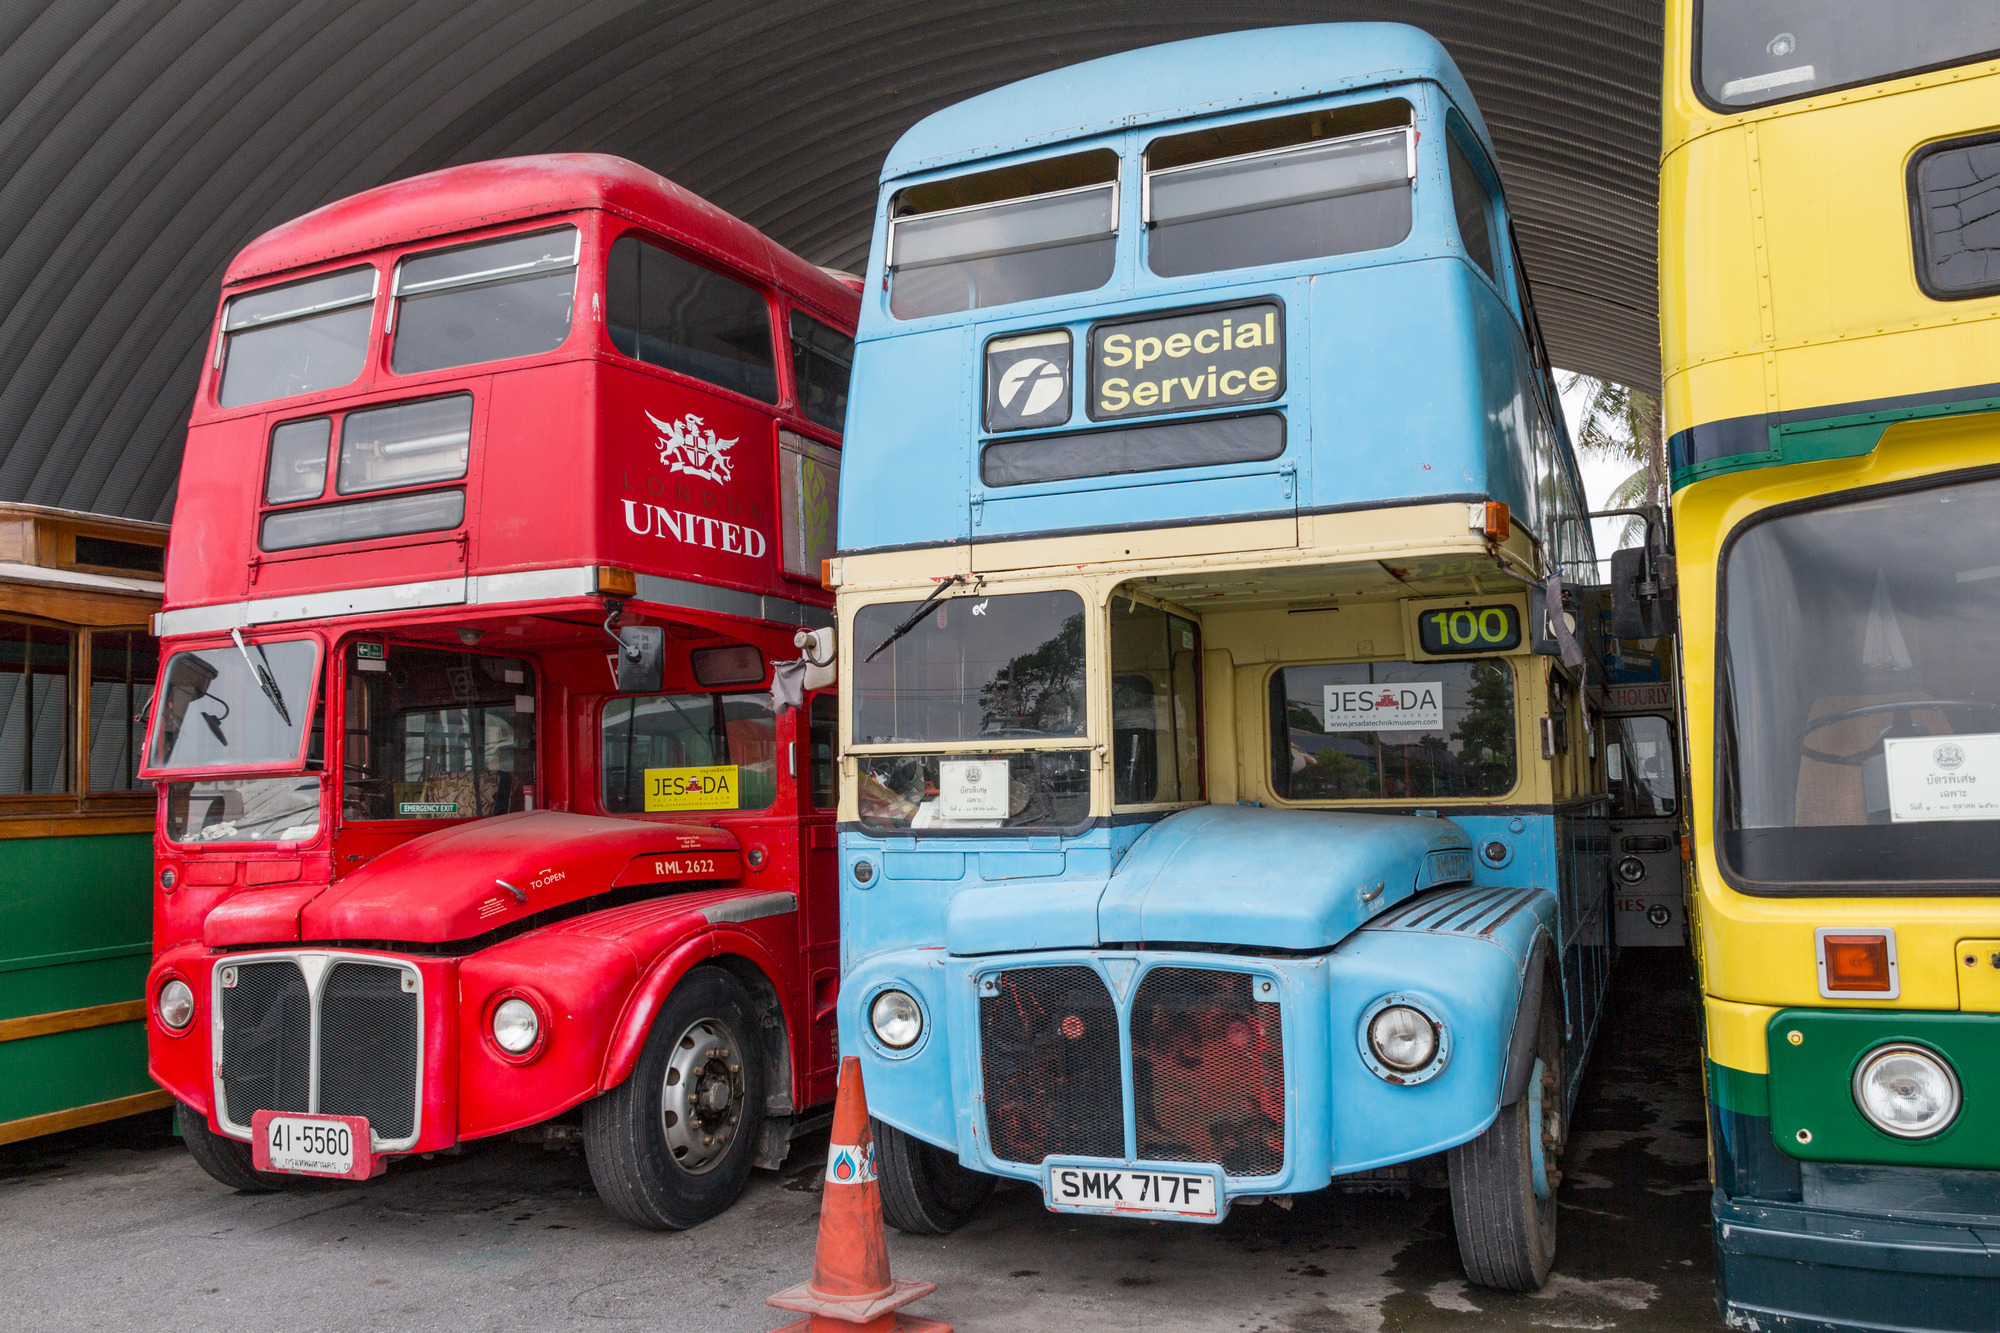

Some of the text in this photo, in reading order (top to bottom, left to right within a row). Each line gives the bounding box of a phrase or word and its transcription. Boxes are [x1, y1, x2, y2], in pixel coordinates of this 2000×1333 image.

[1102, 312, 1275, 370] Special
[1100, 364, 1278, 412] Service
[622, 470, 762, 521] LONDON
[620, 498, 767, 559] UNITED
[1431, 608, 1509, 645] 100
[1617, 688, 1670, 706] HOURLY
[1330, 719, 1438, 729] www.jesadatechnikmuseum.com
[1926, 772, 1976, 785] บัตรพิเศษ
[404, 803, 454, 813] EMERGENCY EXIT
[530, 872, 565, 889] TO OPEN
[655, 859, 715, 875] RML 2622
[272, 1124, 349, 1156] 41-5560
[1061, 1171, 1202, 1204] SMK 717F
